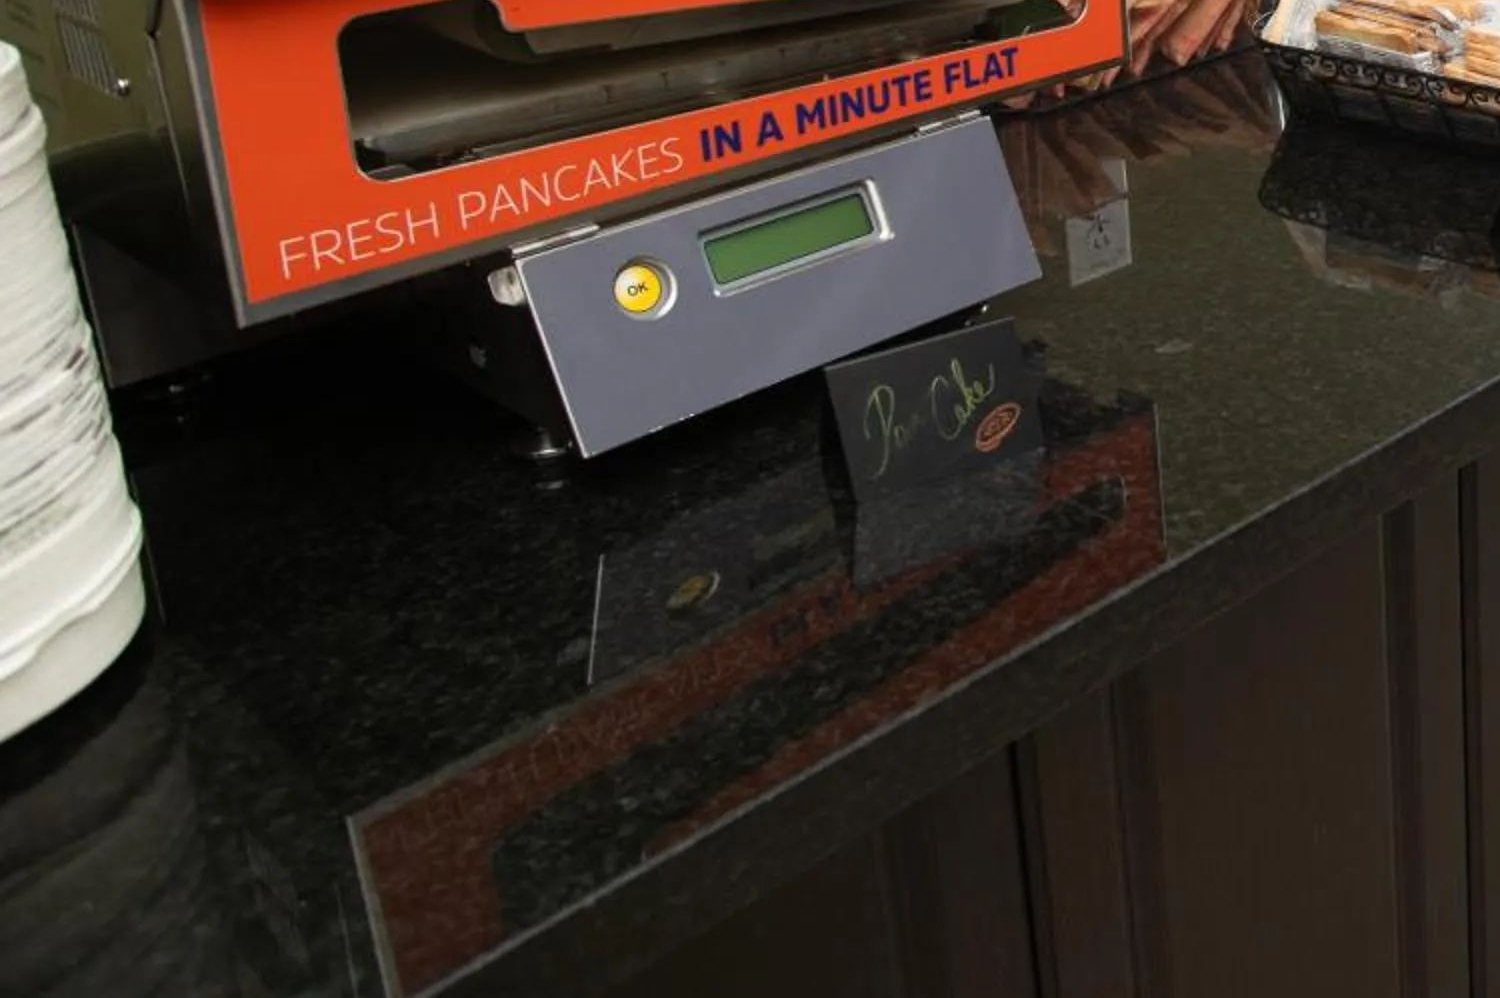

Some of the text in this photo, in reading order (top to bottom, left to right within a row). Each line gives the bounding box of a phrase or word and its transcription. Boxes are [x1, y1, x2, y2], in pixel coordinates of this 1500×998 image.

[278, 47, 1019, 280] FRESH PANCAKES IN A MINUTE FLAT
[627, 282, 649, 296] OK
[930, 356, 997, 441] Cake
